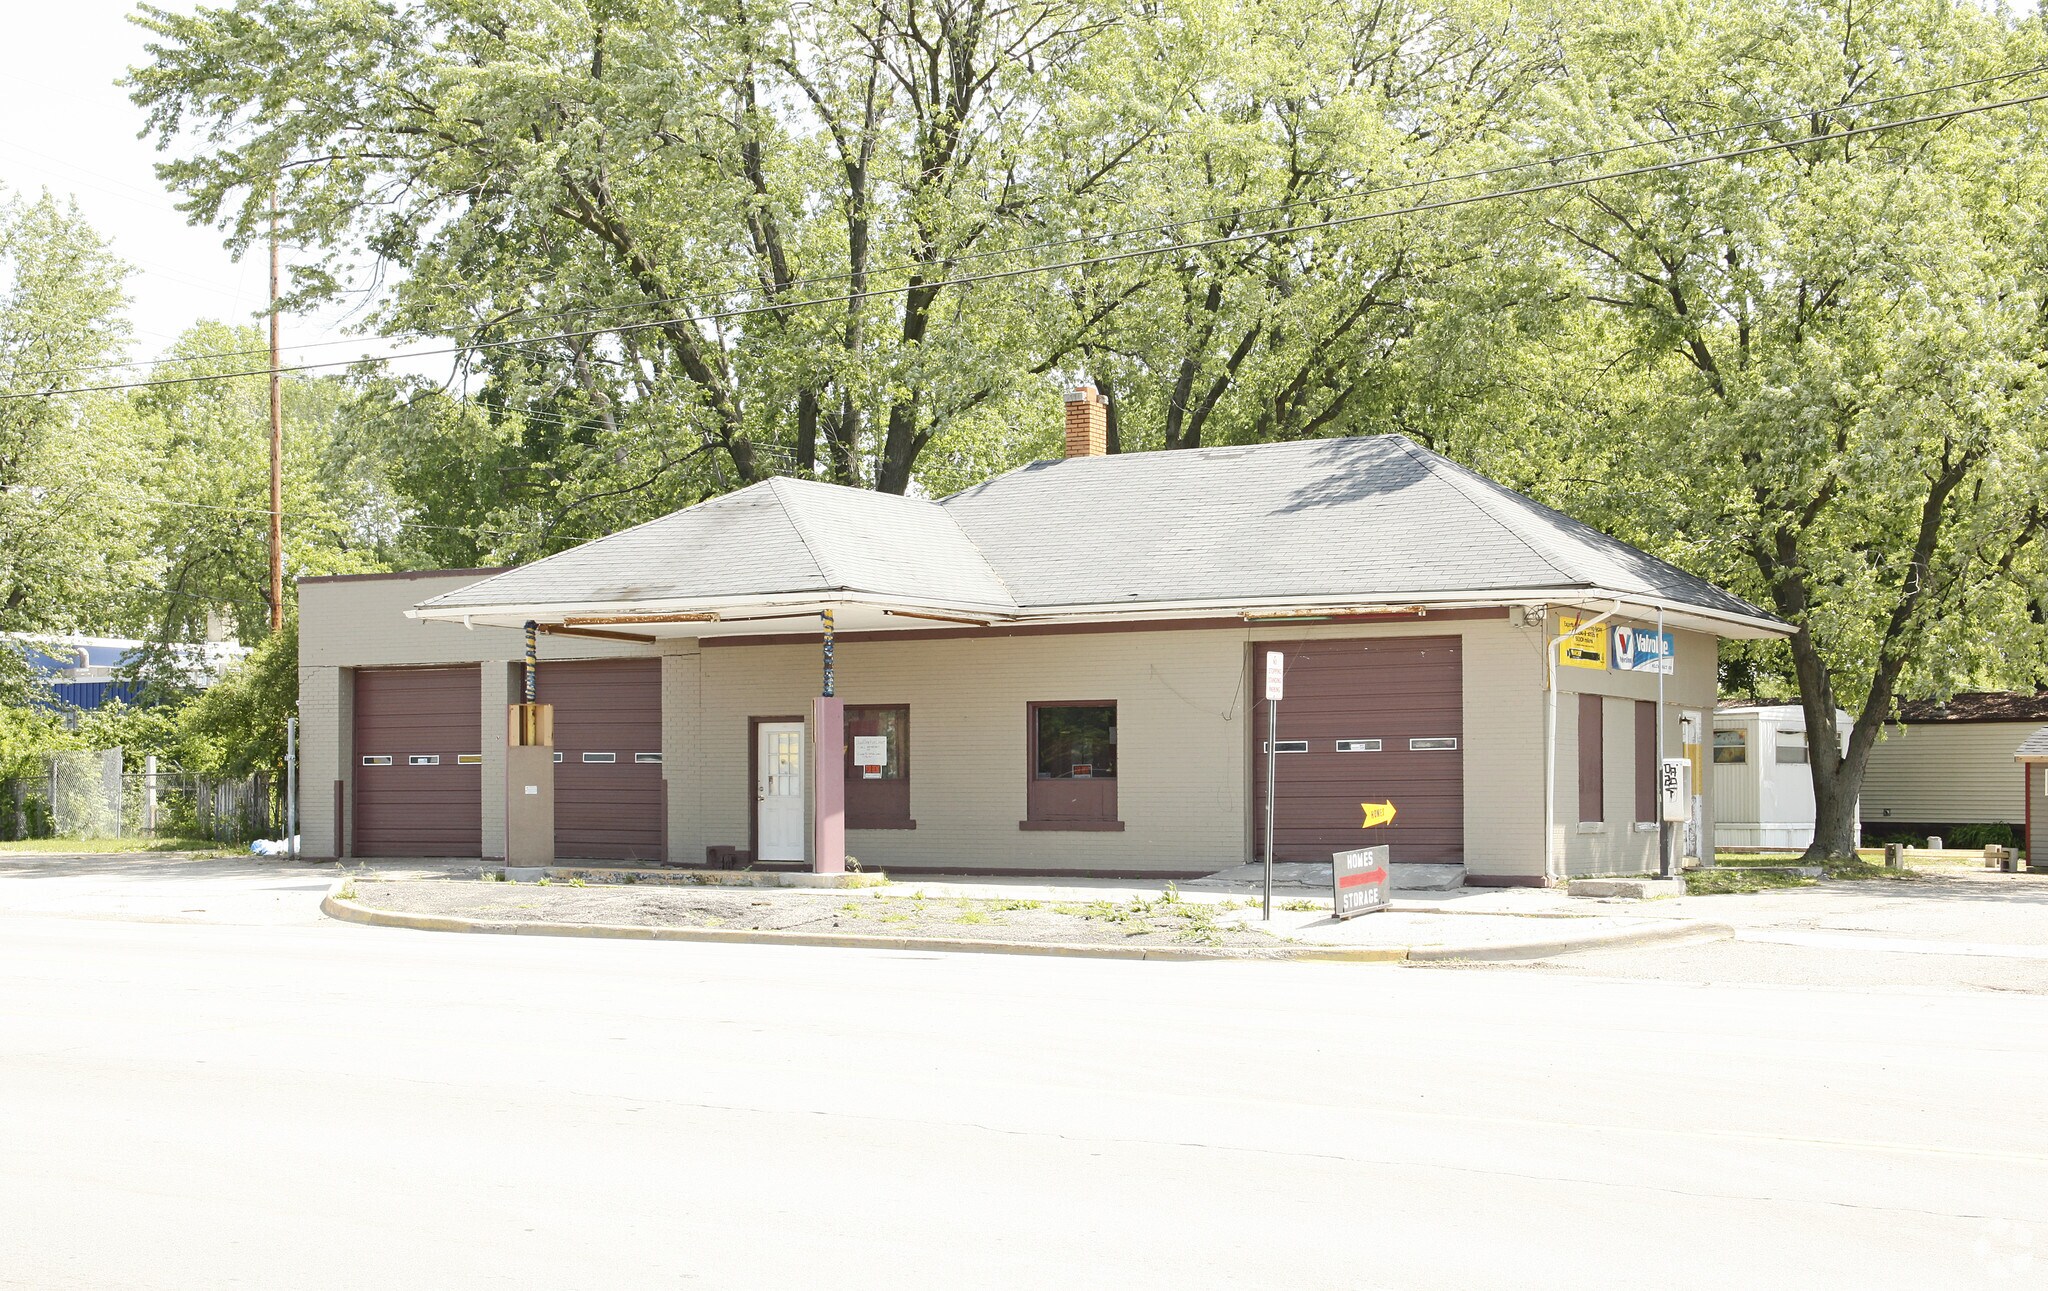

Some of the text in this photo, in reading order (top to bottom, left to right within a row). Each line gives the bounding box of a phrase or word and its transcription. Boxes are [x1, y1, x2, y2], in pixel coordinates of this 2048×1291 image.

[1636, 633, 1669, 655] Valvole
[1371, 808, 1385, 819] HOMES
[1347, 851, 1374, 870] HOMES
[1343, 887, 1379, 909] STORAGE
